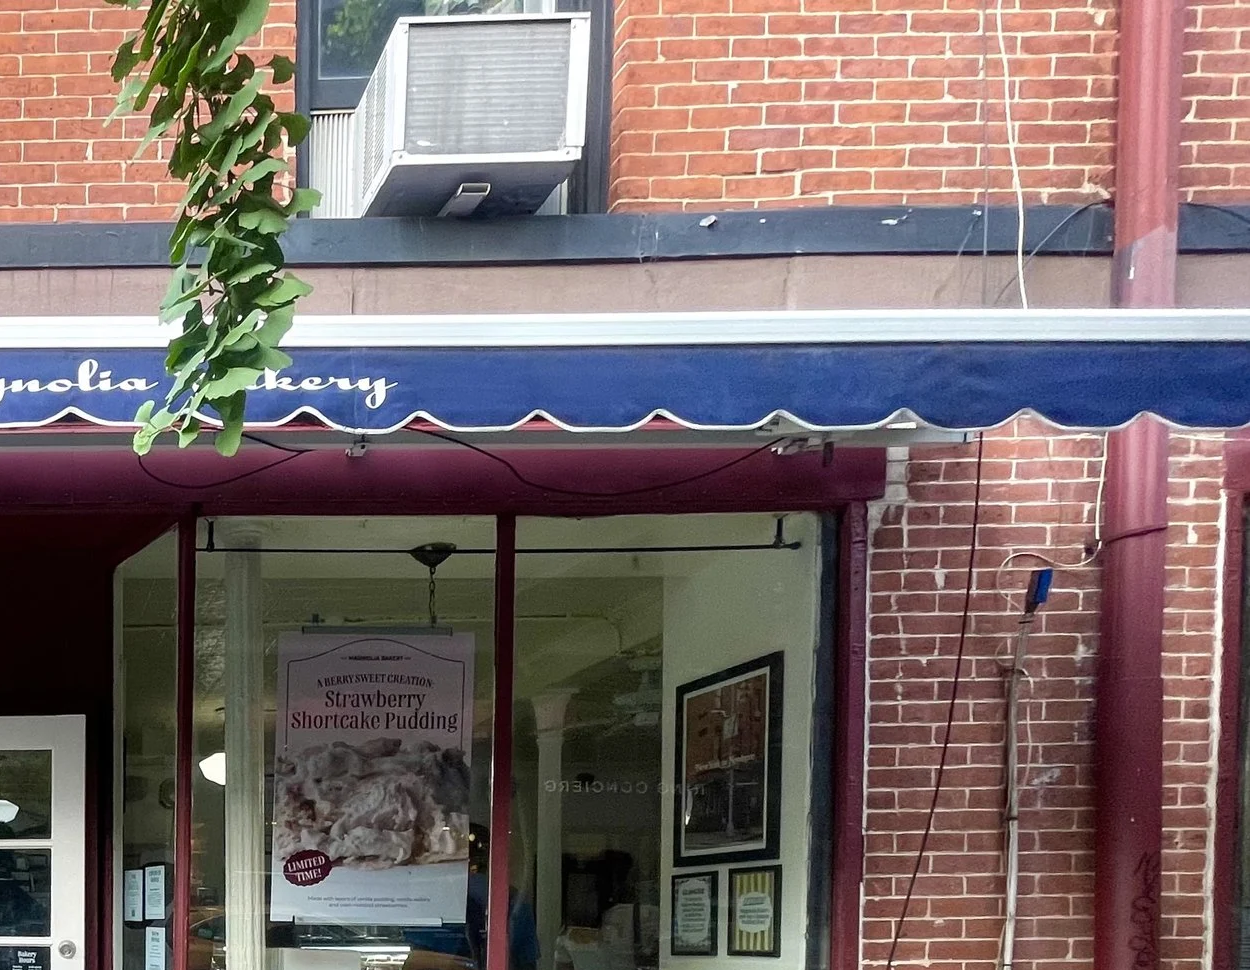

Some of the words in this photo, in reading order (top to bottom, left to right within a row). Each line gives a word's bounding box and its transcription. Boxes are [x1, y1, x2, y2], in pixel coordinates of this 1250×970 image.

[317, 679, 325, 689] A
[324, 675, 357, 688] BERRY
[355, 673, 387, 685] SWEET
[325, 690, 427, 711] Strawberry
[290, 711, 381, 730] Shortcake
[385, 711, 459, 733] Pudding
[287, 855, 326, 873] LIMITED
[297, 867, 323, 882] TIME!
[17, 950, 38, 959] Bakery
